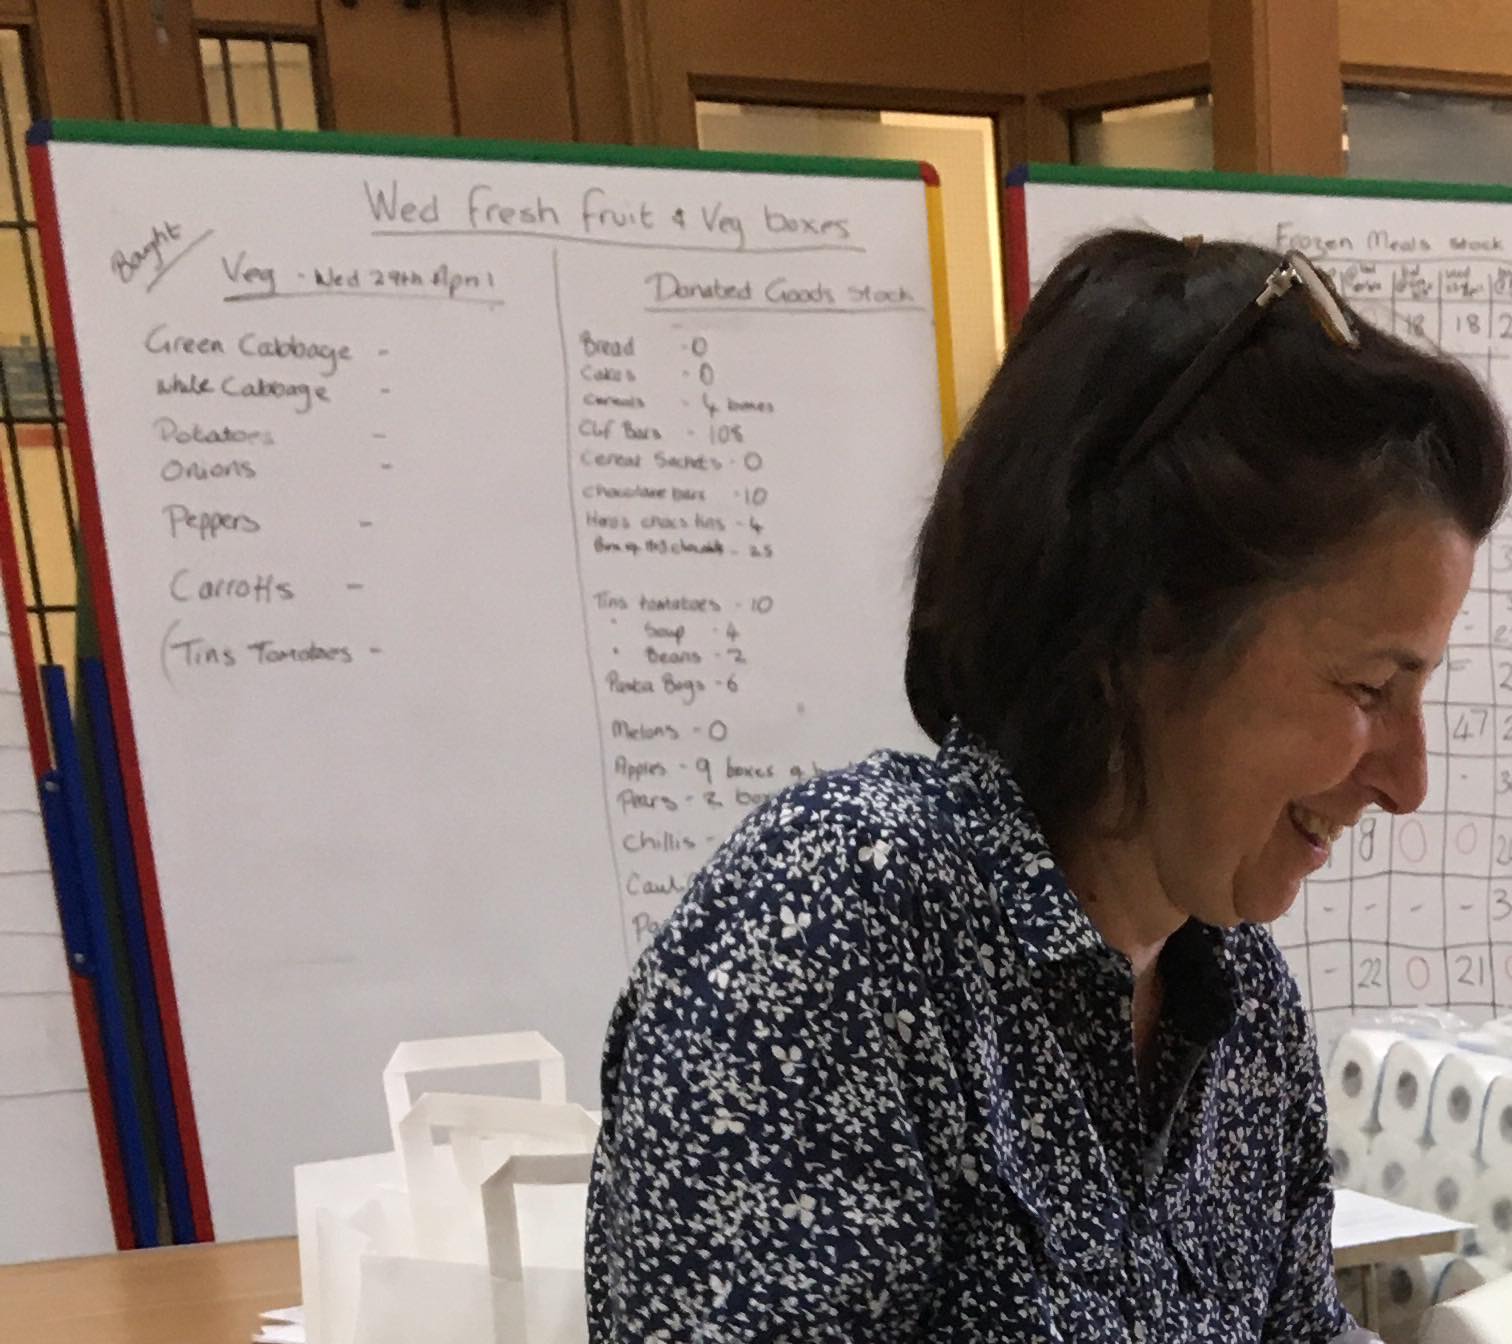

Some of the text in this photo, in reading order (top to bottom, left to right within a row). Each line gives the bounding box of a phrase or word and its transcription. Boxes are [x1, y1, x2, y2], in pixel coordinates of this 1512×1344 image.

[364, 180, 438, 223] Wed
[702, 202, 746, 251] Veg
[764, 204, 849, 238] boxes
[221, 251, 276, 296] Veg
[314, 261, 358, 287] Wed
[645, 272, 751, 301] Donated
[764, 278, 835, 303] Goods
[144, 324, 352, 377] Green Cabbage
[580, 331, 635, 356] Bread
[221, 376, 330, 414] Cabbage
[160, 459, 256, 481] Onions
[743, 451, 762, 471] 0
[745, 487, 768, 506] 10
[163, 504, 260, 539] Peppers
[752, 595, 773, 613] 10
[645, 646, 701, 665] Beans
[727, 672, 739, 692] 6
[612, 719, 727, 742] Melons 0
[1453, 709, 1489, 741] 47
[622, 831, 695, 852] Chillis
[1358, 957, 1382, 989] 22
[1406, 955, 1430, 991] 0
[1455, 955, 1484, 986] 21
